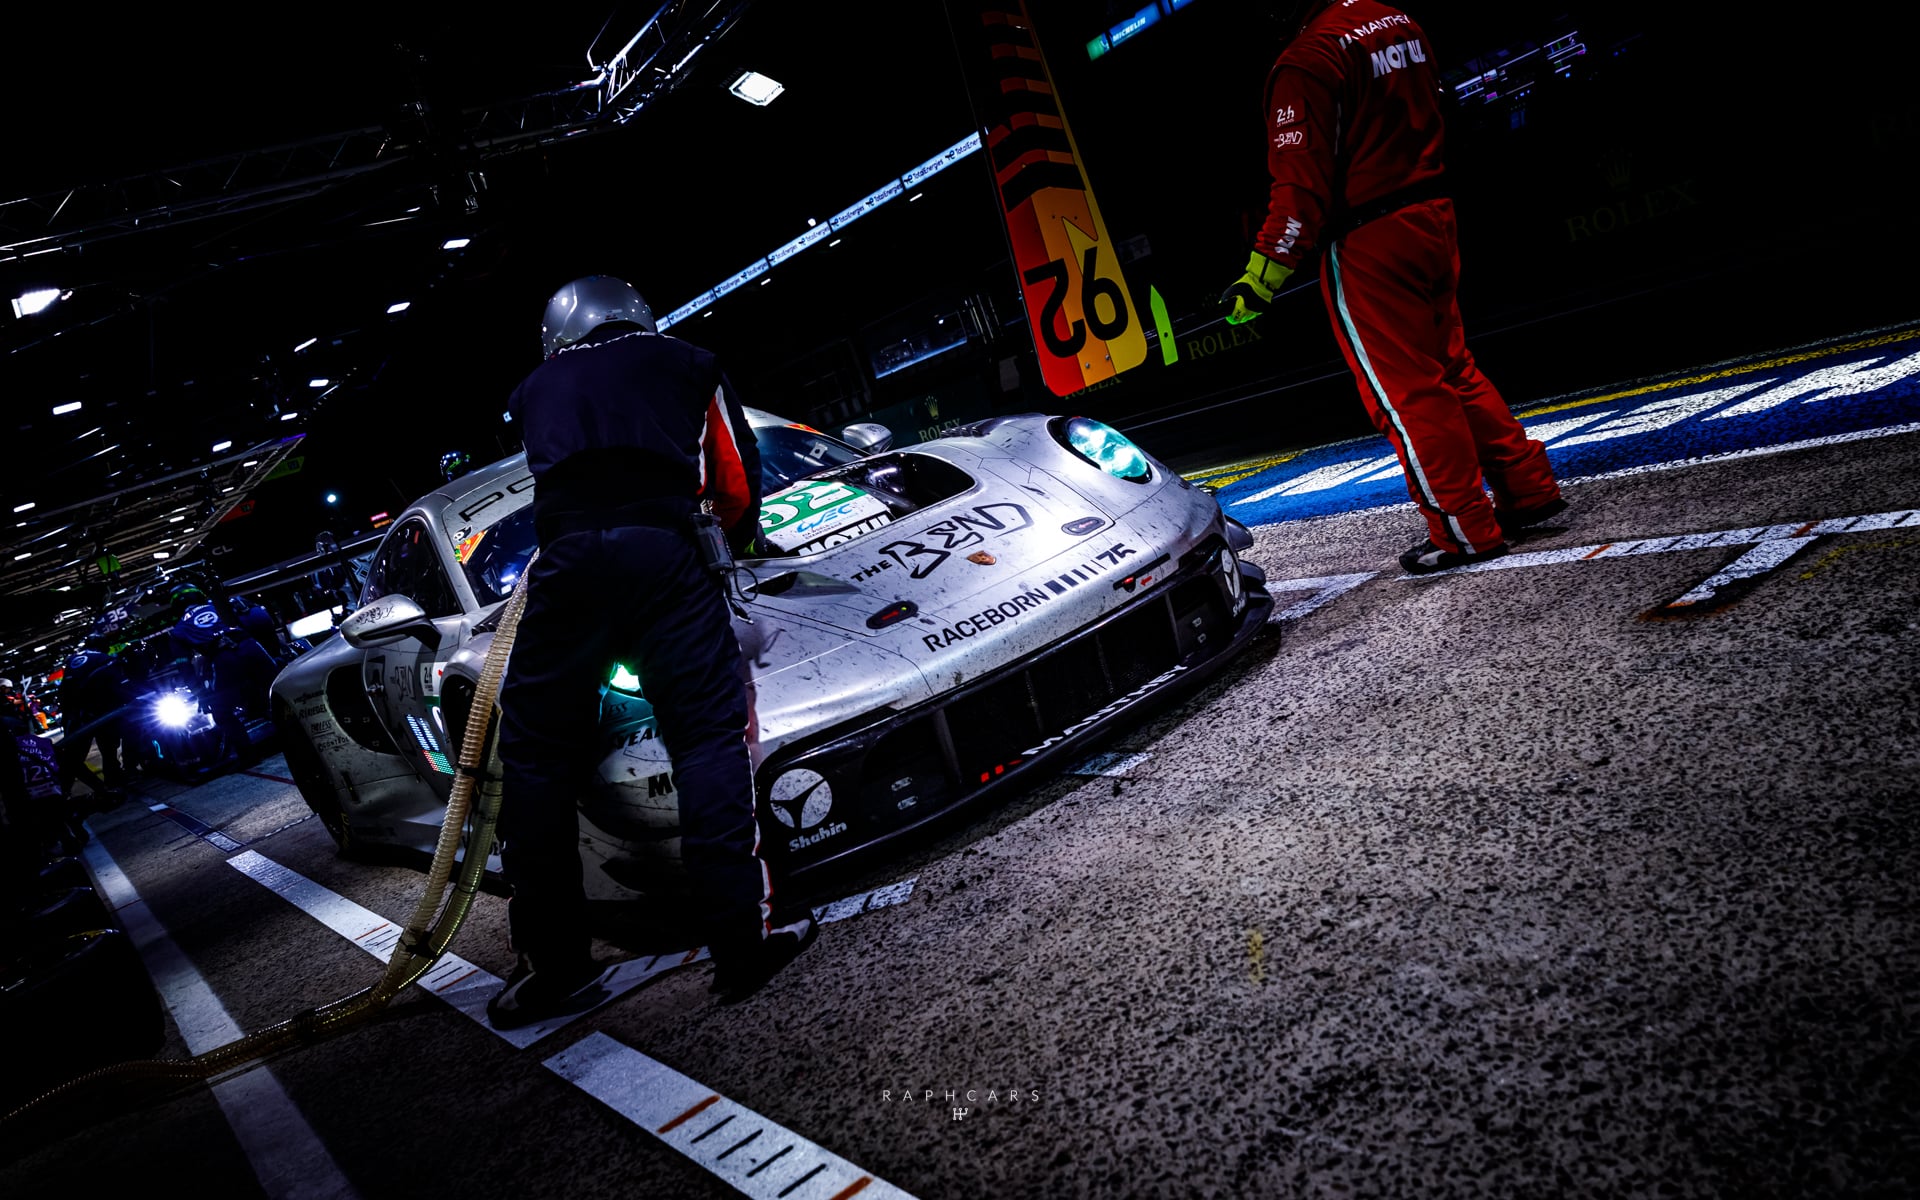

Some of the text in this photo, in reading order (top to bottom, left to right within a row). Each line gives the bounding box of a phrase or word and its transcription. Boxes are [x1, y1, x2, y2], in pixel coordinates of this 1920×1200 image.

[1112, 17, 1146, 42] MICHELIN
[1370, 38, 1426, 79] MOTUL
[851, 502, 1035, 583] THE BEND
[922, 543, 1137, 652] RACEBORN 75
[1020, 664, 1188, 756] MANTHEY
[789, 821, 848, 853] Shahin
